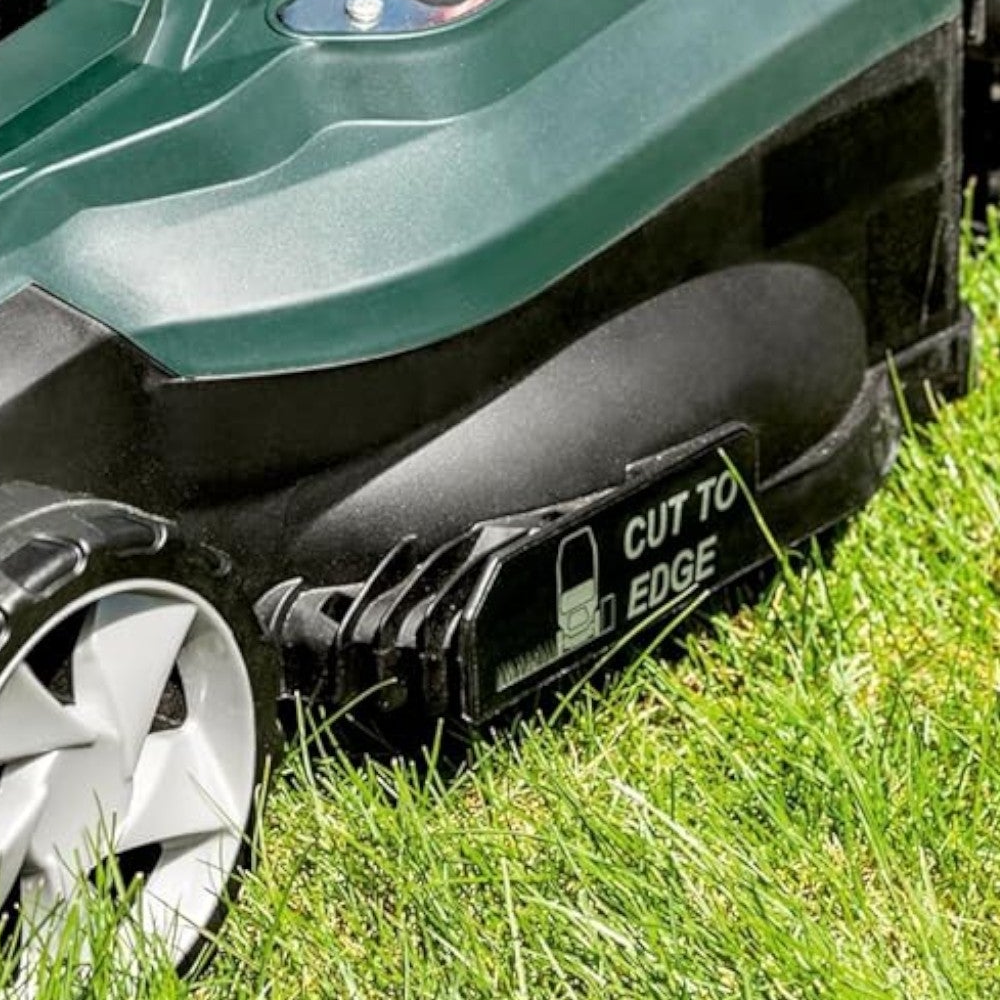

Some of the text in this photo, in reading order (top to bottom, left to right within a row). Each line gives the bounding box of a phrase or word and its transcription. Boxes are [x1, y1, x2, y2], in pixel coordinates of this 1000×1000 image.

[622, 470, 738, 561] CUT TO
[626, 535, 719, 620] EDGE
